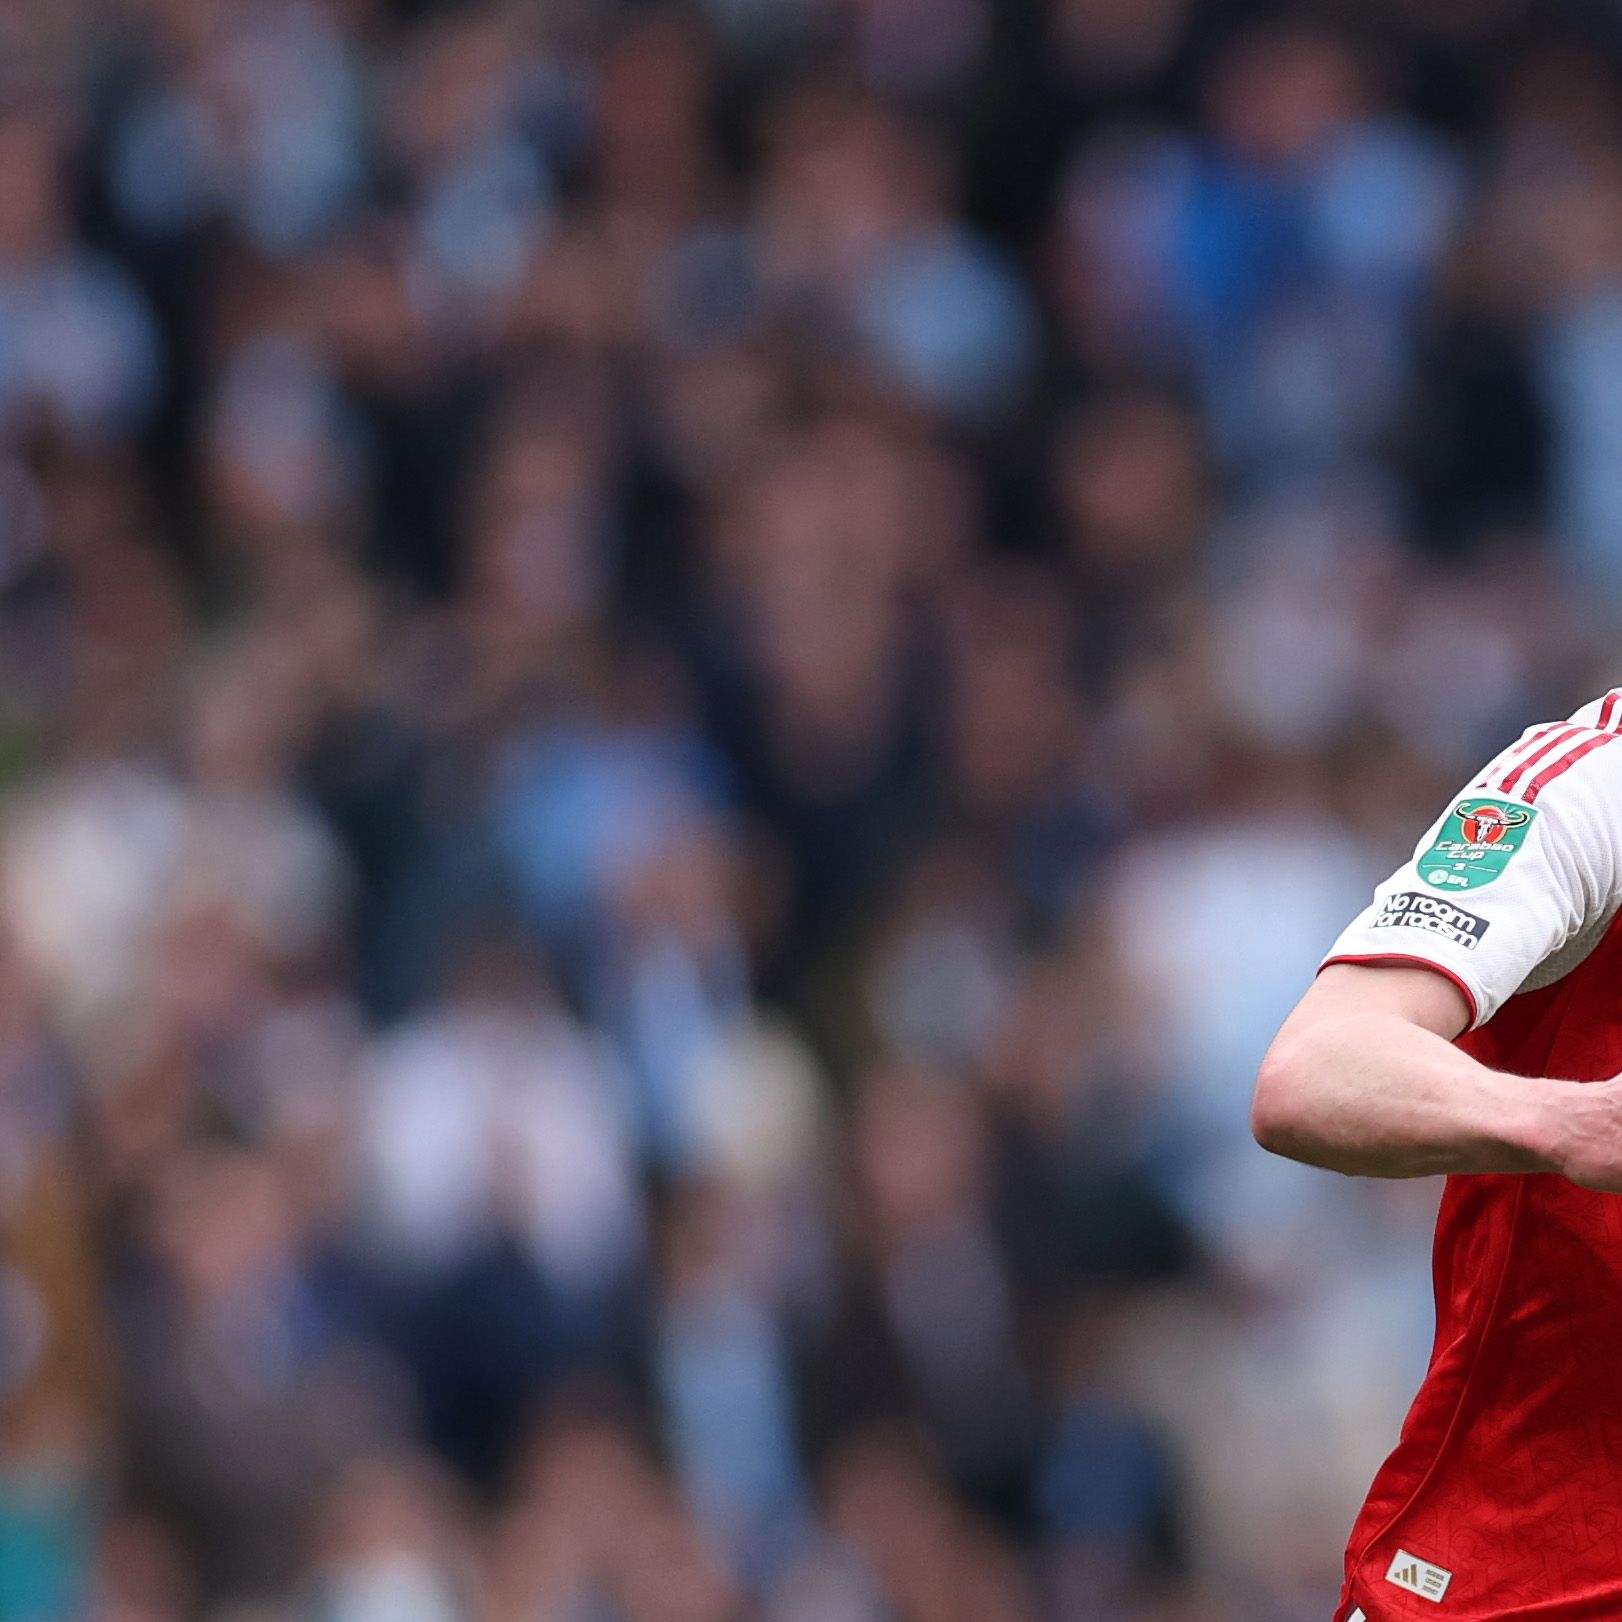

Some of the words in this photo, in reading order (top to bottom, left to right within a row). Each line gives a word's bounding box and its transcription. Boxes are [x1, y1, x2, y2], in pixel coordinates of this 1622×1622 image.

[1435, 840, 1515, 852] Carabao
[1446, 850, 1486, 860] Cup
[1383, 893, 1411, 911] No
[1409, 896, 1477, 933] room
[1399, 911, 1478, 950] racism
